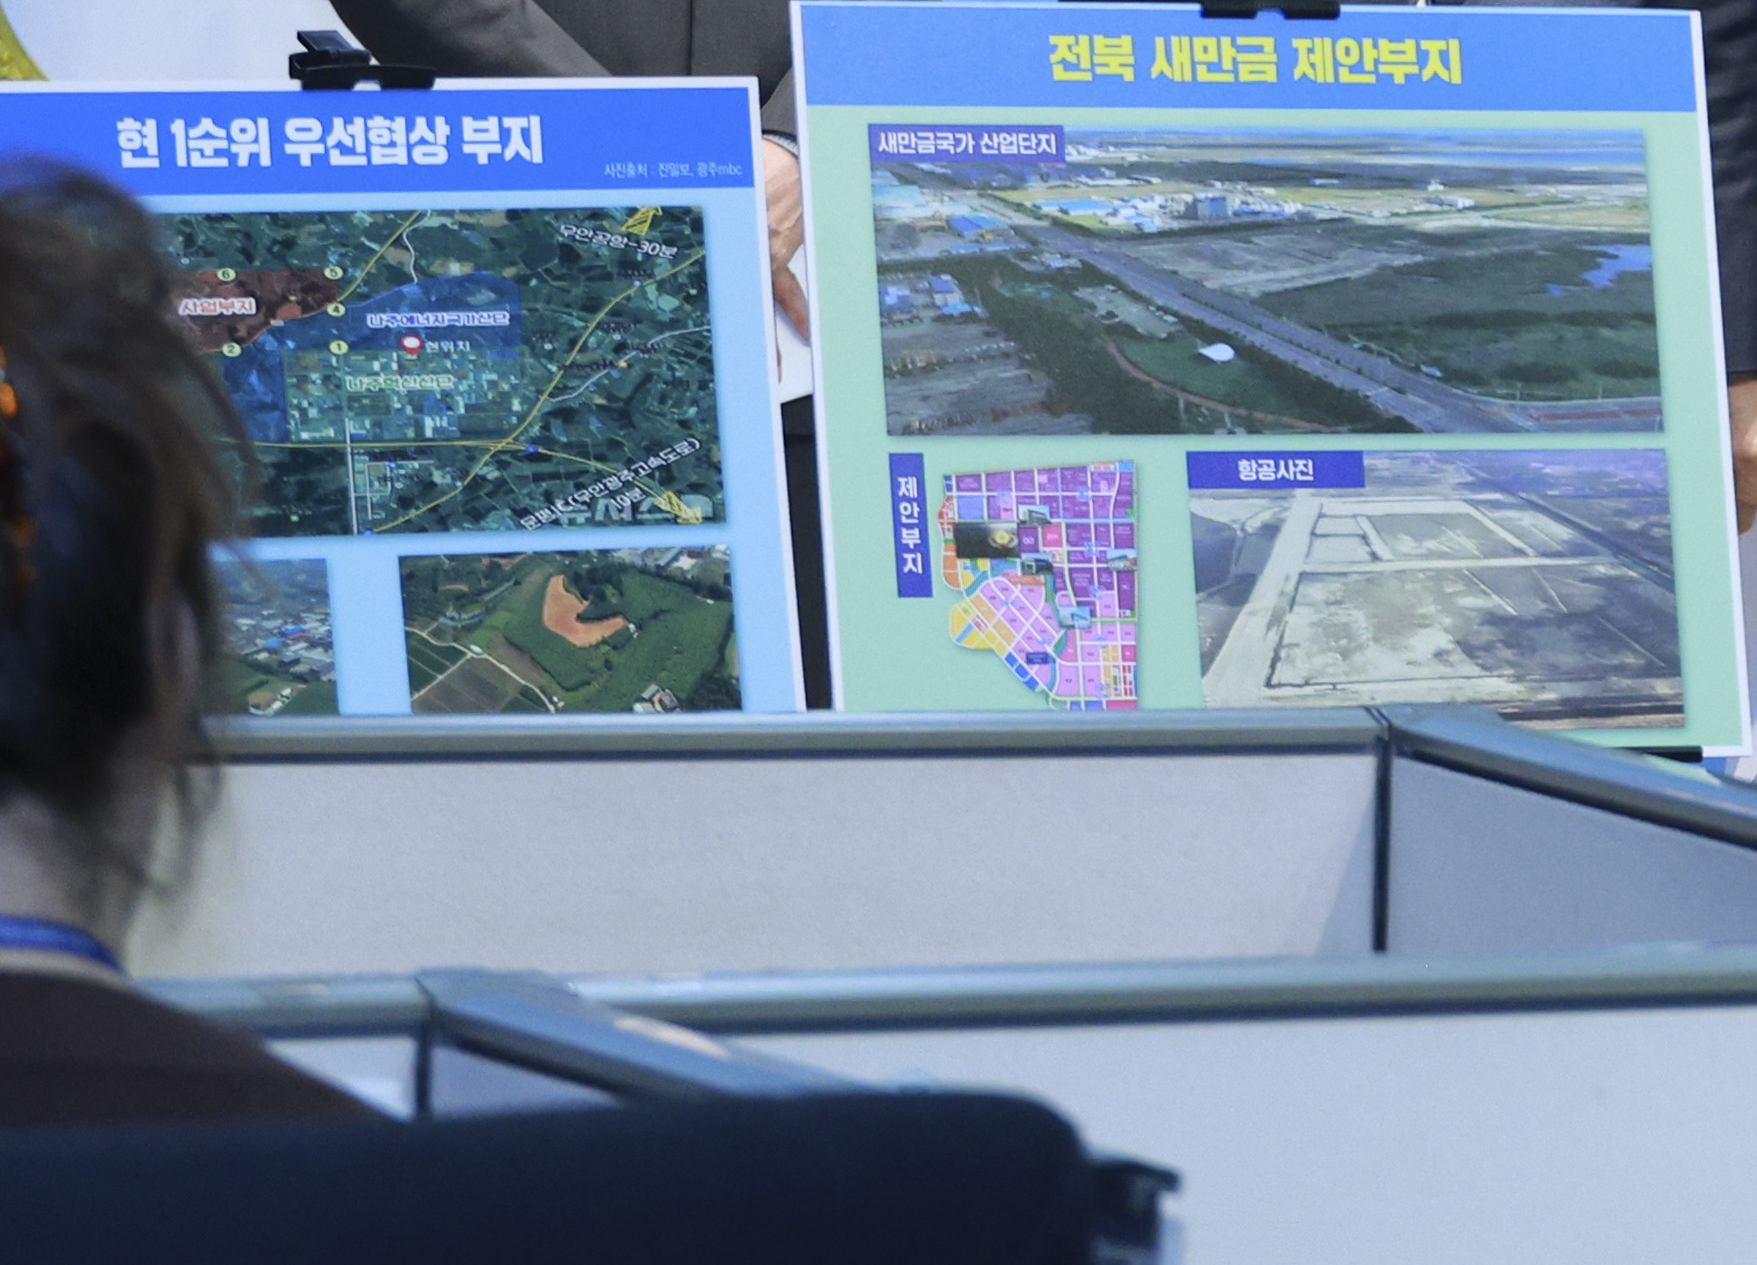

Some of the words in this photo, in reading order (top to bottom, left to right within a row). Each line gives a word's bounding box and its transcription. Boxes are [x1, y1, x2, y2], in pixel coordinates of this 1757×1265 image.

[1048, 34, 1136, 84] 전북
[1149, 34, 1278, 83] 새만금
[1291, 36, 1463, 86] 제안부지
[117, 117, 160, 168] 현
[171, 117, 272, 168] 1순위
[284, 115, 451, 167] 우선협상
[461, 115, 543, 165] 부지
[878, 131, 976, 155] 새만금국가
[979, 132, 1058, 155] 산업단지
[178, 296, 257, 316] 사업부지
[425, 341, 471, 353] 현위치
[1237, 458, 1315, 482] 항공사진
[897, 476, 923, 574] 제안부지
